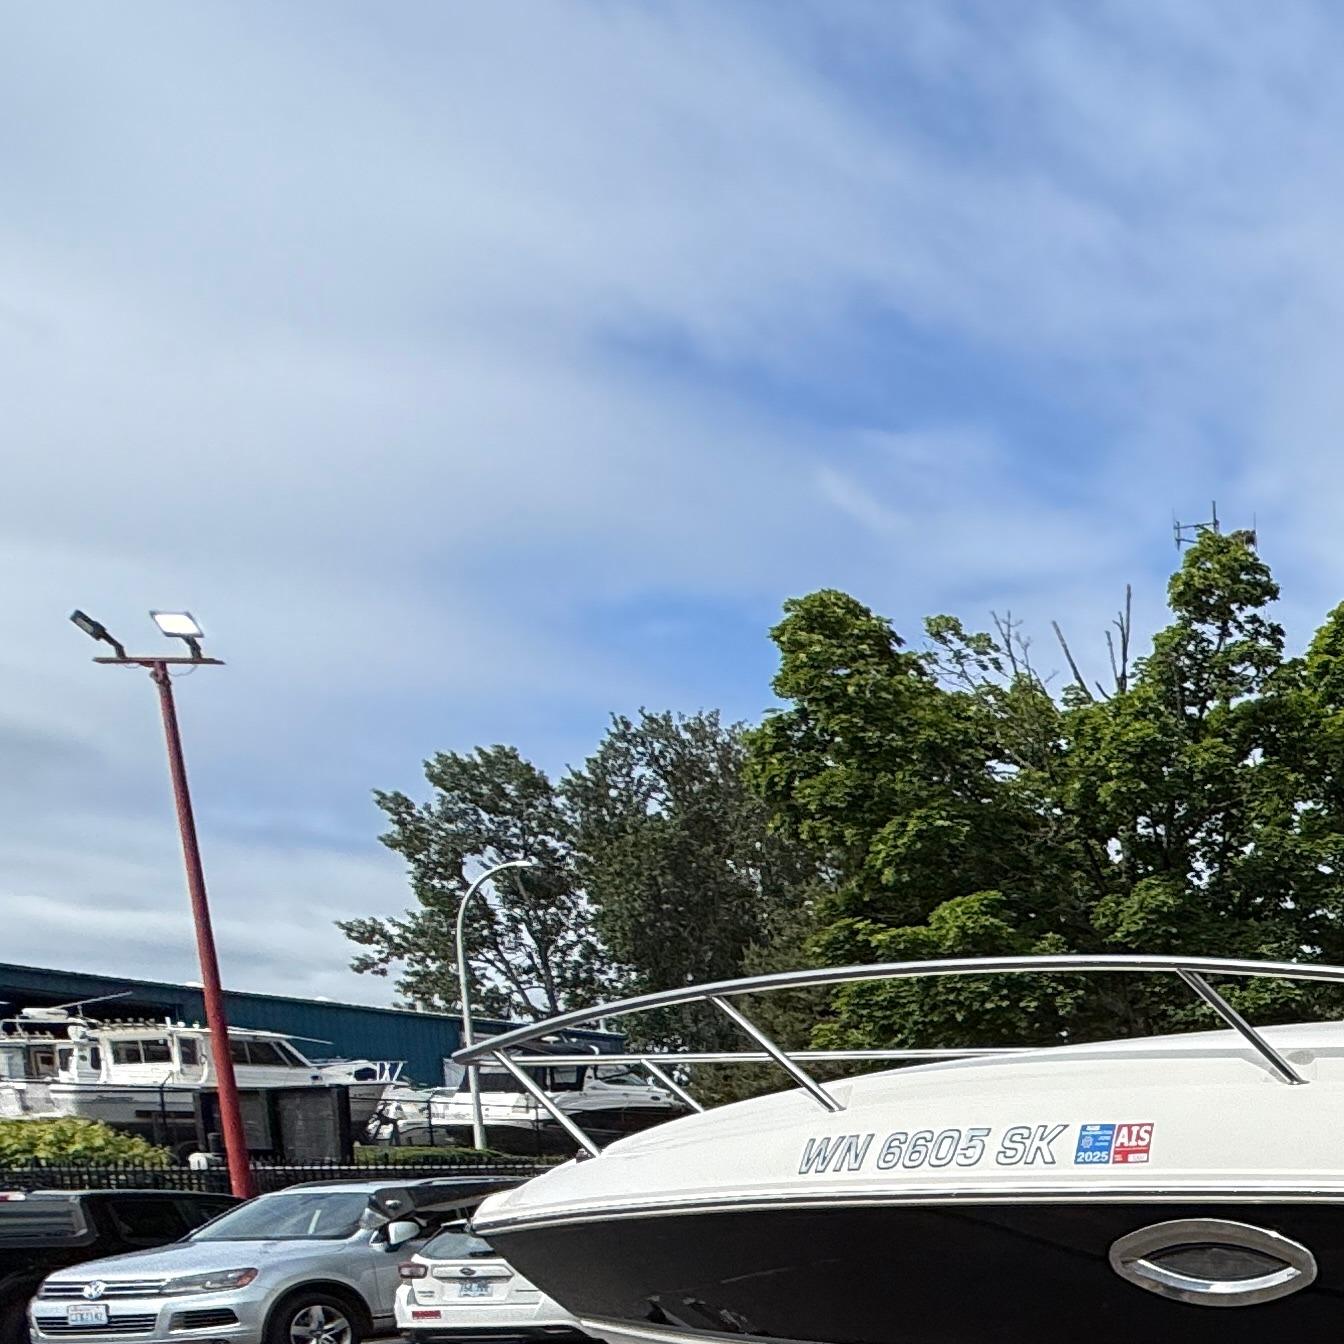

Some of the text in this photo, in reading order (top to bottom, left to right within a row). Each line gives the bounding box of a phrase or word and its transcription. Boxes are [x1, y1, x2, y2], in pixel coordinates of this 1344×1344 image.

[1115, 1125, 1152, 1147] AIS
[798, 1133, 875, 1175] WN
[876, 1128, 991, 1170] 6605
[995, 1124, 1069, 1165] SK
[1076, 1150, 1109, 1163] 2025
